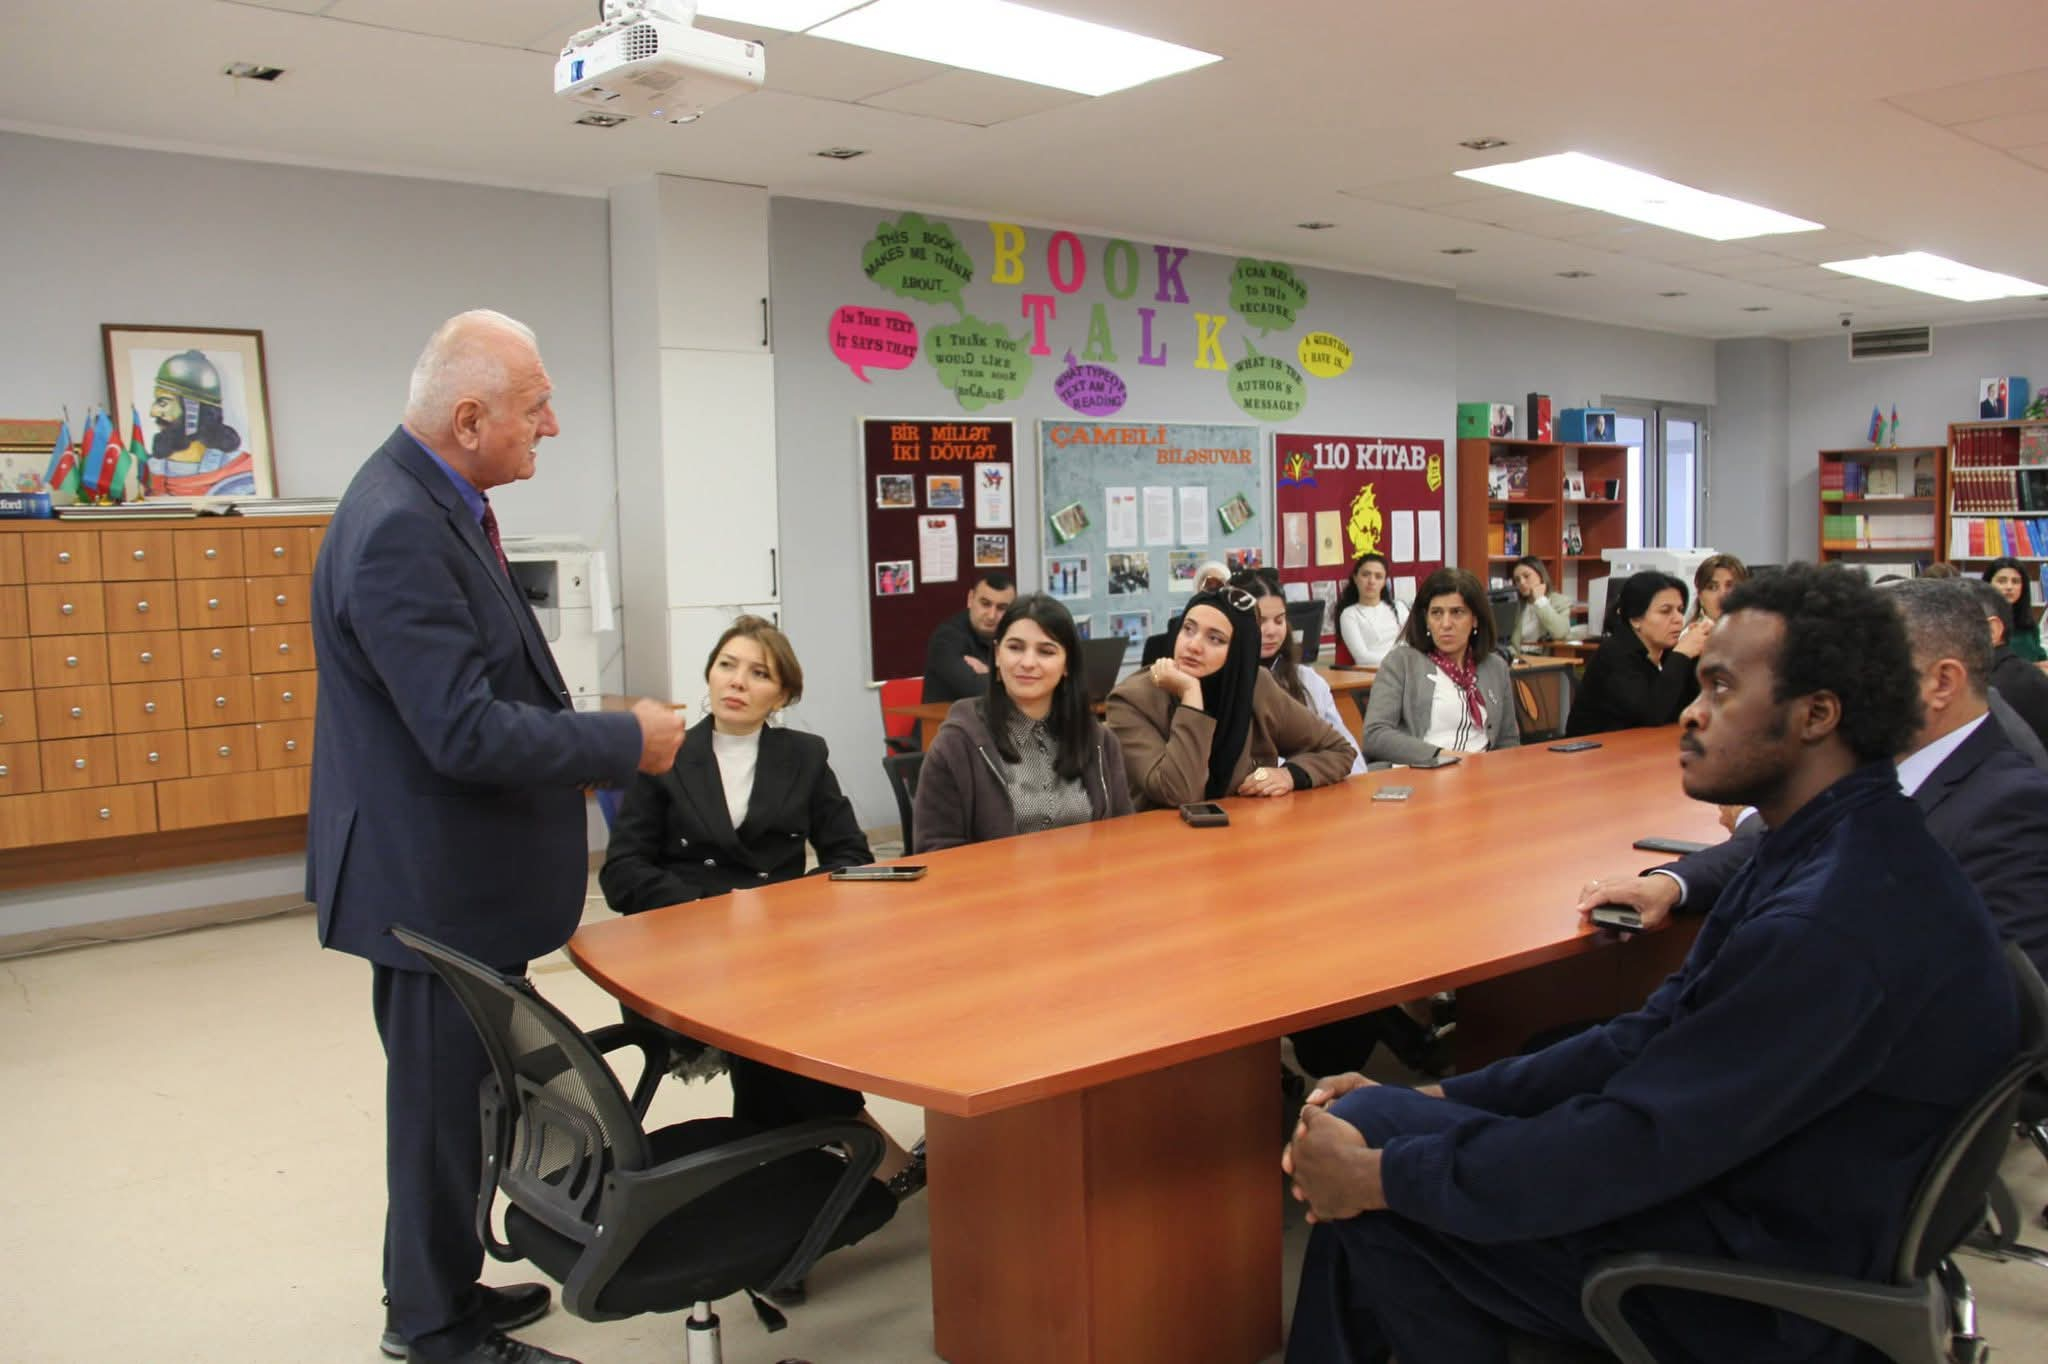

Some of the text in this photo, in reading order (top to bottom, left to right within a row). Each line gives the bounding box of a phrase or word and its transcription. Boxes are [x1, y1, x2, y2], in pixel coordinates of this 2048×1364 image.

[923, 231, 956, 253] BOOK
[864, 246, 905, 278] MAKES
[988, 221, 1190, 304] BOOK
[935, 335, 942, 347] I
[1021, 293, 1229, 371] TALK
[851, 335, 884, 351] SAYS
[886, 341, 917, 358] THAT
[1235, 356, 1265, 372] WHAT
[1270, 357, 1282, 370] IS
[1055, 366, 1082, 387] WHAT
[1061, 380, 1086, 400] TEXT
[1313, 443, 1350, 470] 110
[0, 498, 23, 510] ford
